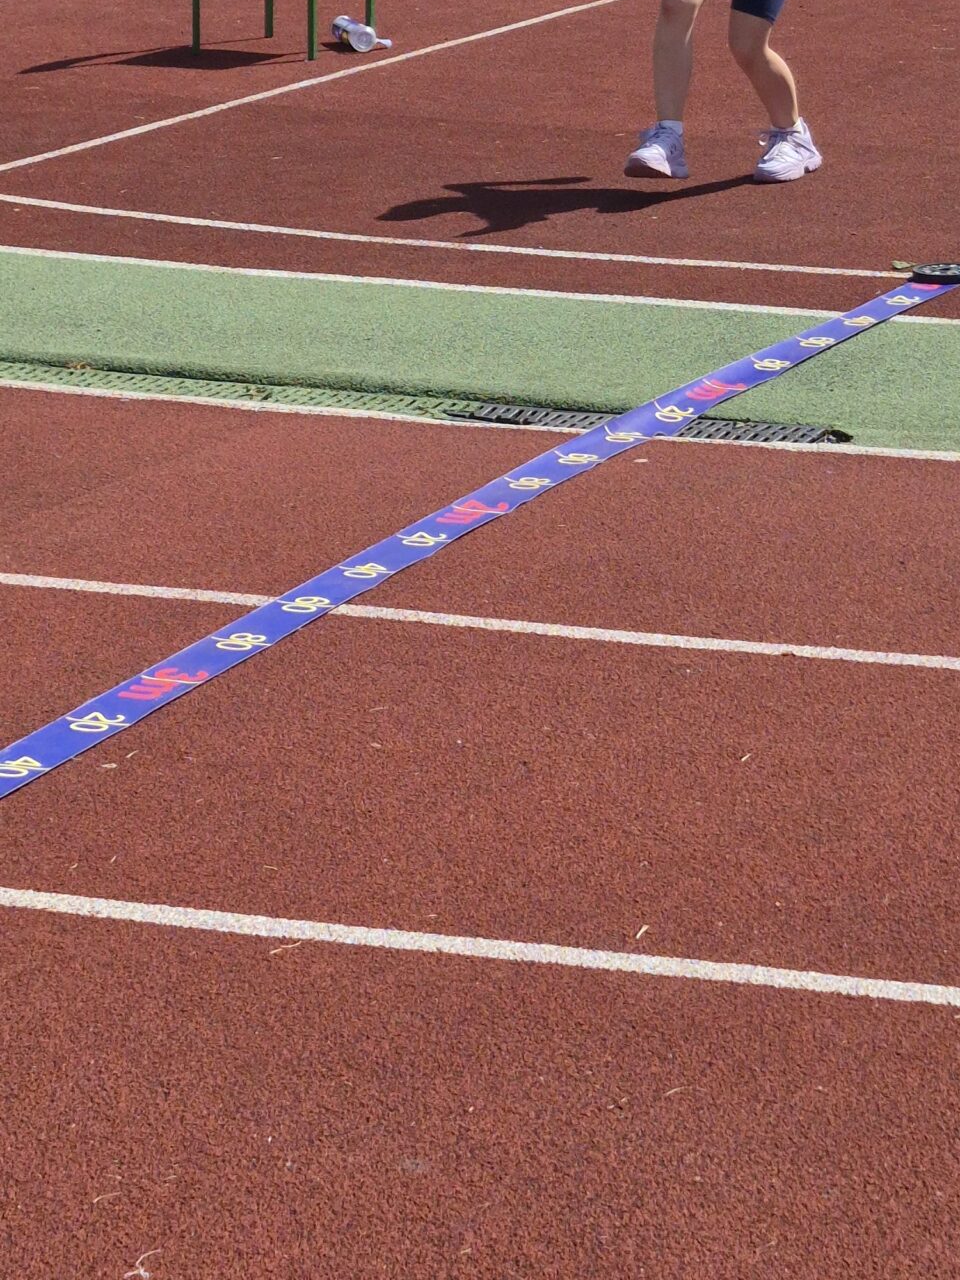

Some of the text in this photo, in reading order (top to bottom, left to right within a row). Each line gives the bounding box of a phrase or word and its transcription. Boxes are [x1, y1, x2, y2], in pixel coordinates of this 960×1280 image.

[655, 405, 694, 423] 20
[557, 452, 598, 465] 60
[508, 476, 550, 490] 80
[436, 499, 510, 525] 2m
[402, 531, 447, 548] 20
[343, 561, 387, 579] 40
[281, 595, 331, 614] 60
[215, 632, 267, 651] 80
[118, 667, 209, 702] 3m
[69, 711, 126, 733] 20
[0, 755, 42, 779] 40
